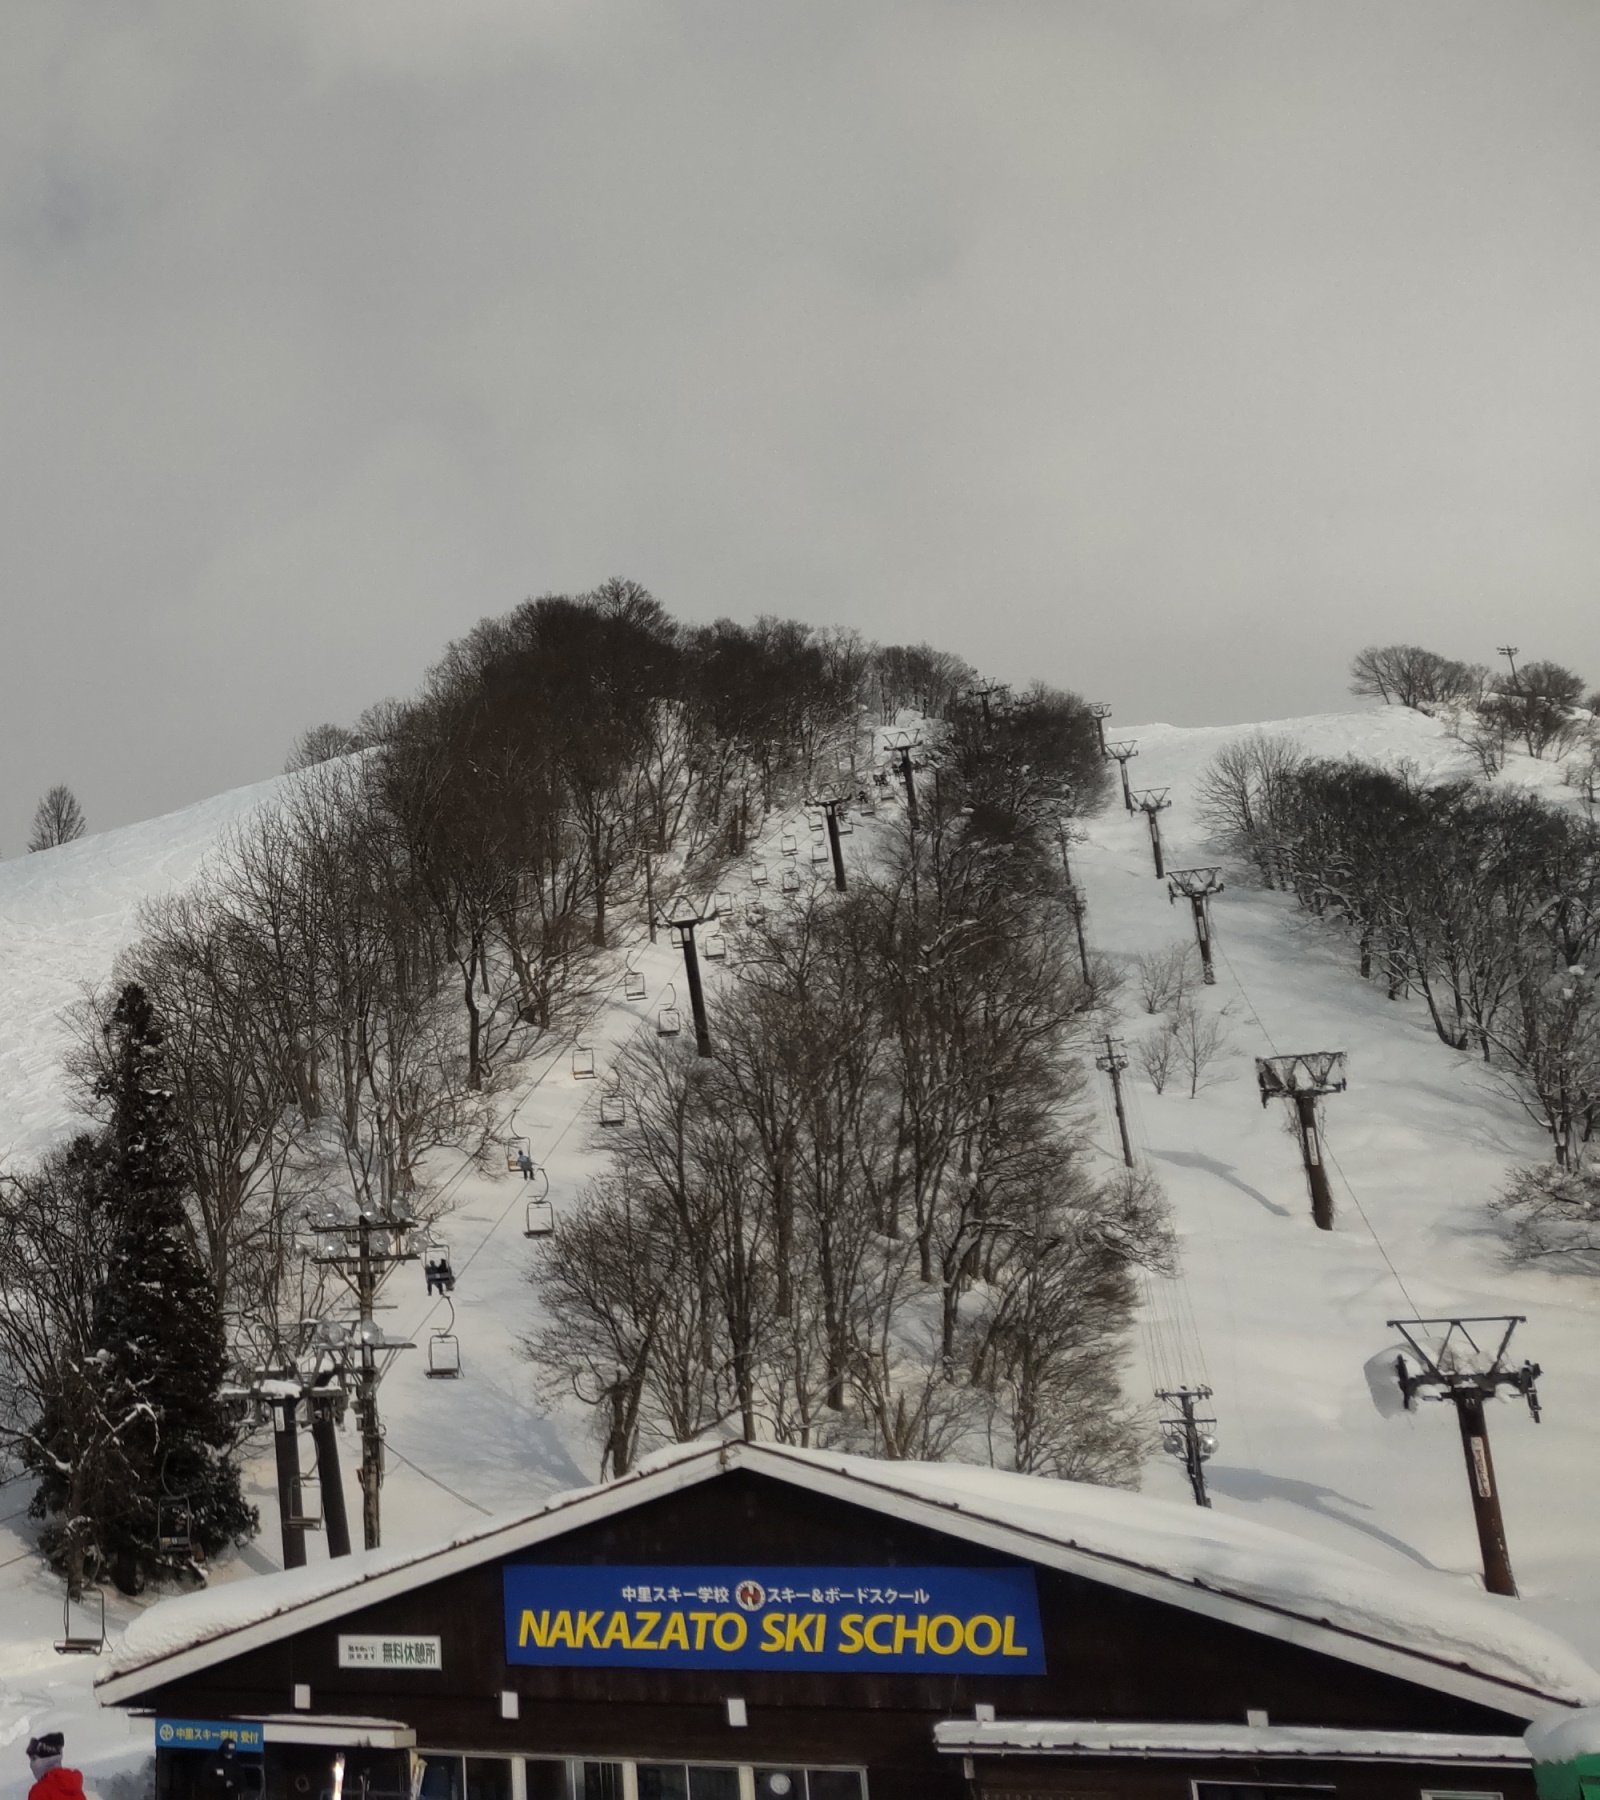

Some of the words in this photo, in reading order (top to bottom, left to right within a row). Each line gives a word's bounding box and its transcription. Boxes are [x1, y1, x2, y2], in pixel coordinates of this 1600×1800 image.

[622, 1586, 730, 1603] 中里スキー学校
[767, 1587, 930, 1604] スキー&ボードスクール
[518, 1610, 748, 1652] NAKAZATO
[760, 1612, 826, 1653] SKI
[838, 1614, 1028, 1656] SCHOOL
[382, 1642, 436, 1664] 無料休憩所
